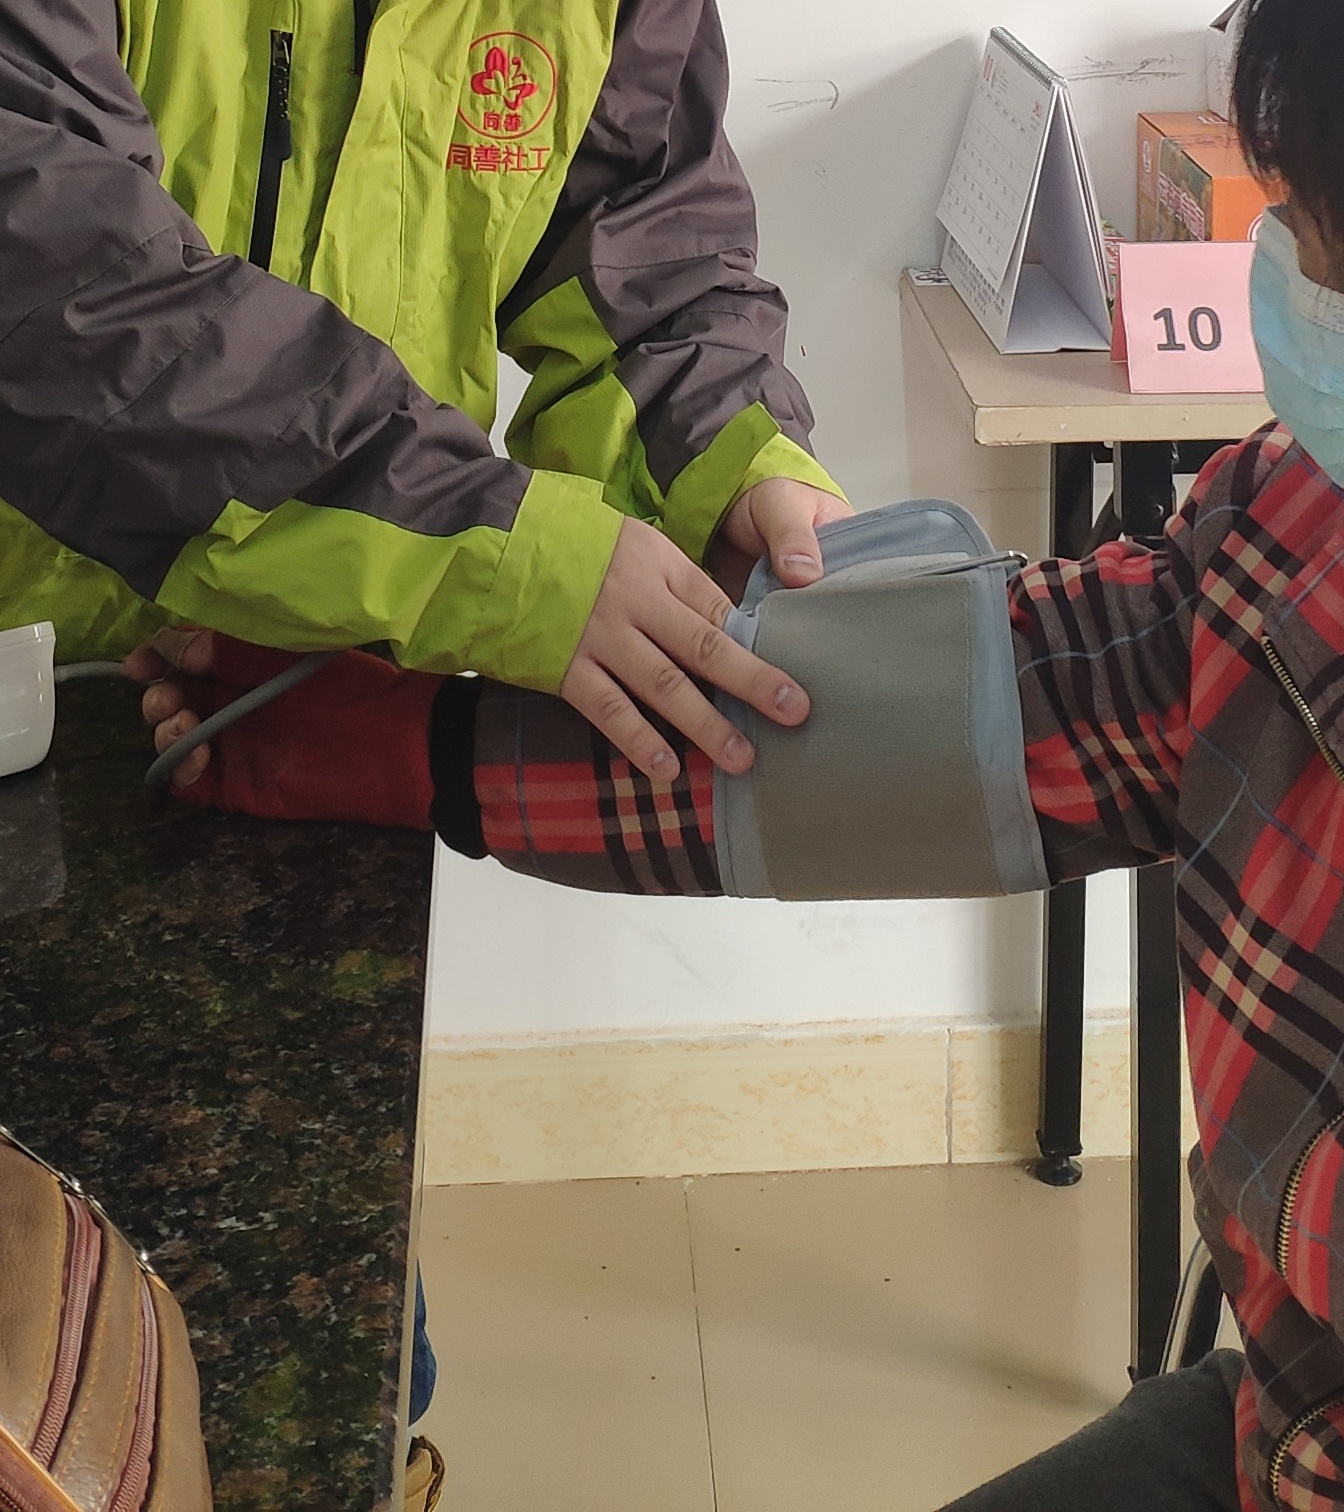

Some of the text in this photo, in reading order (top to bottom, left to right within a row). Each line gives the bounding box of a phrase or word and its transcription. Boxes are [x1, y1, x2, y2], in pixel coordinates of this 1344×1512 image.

[446, 144, 550, 173] 同善社工
[1152, 306, 1223, 353] 10
